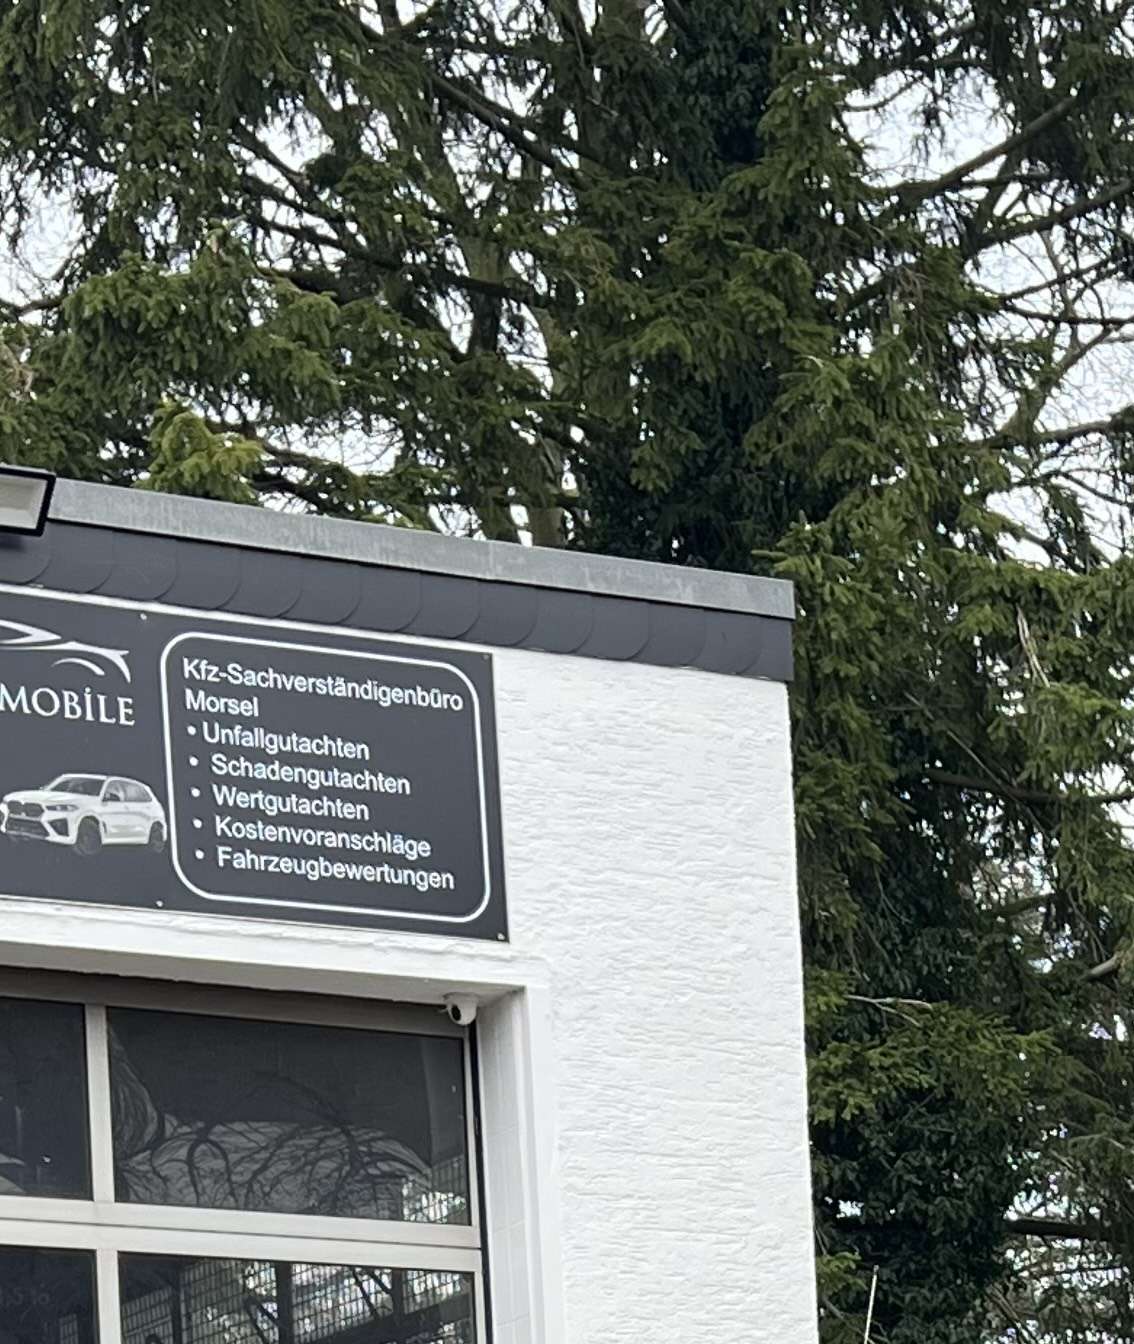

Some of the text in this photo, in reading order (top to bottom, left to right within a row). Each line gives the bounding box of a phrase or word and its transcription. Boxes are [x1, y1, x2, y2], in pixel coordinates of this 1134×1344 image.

[183, 657, 464, 711] Kfz-Sachverständigenbüro
[185, 688, 259, 717] Morsel
[203, 721, 370, 761] Unfallgutachten
[211, 753, 411, 795] Schadengutachten
[212, 784, 370, 821] Wertgutachten
[215, 815, 432, 861] Kostenvoranschläge
[217, 846, 455, 892] Fahrzeugbewertungen
